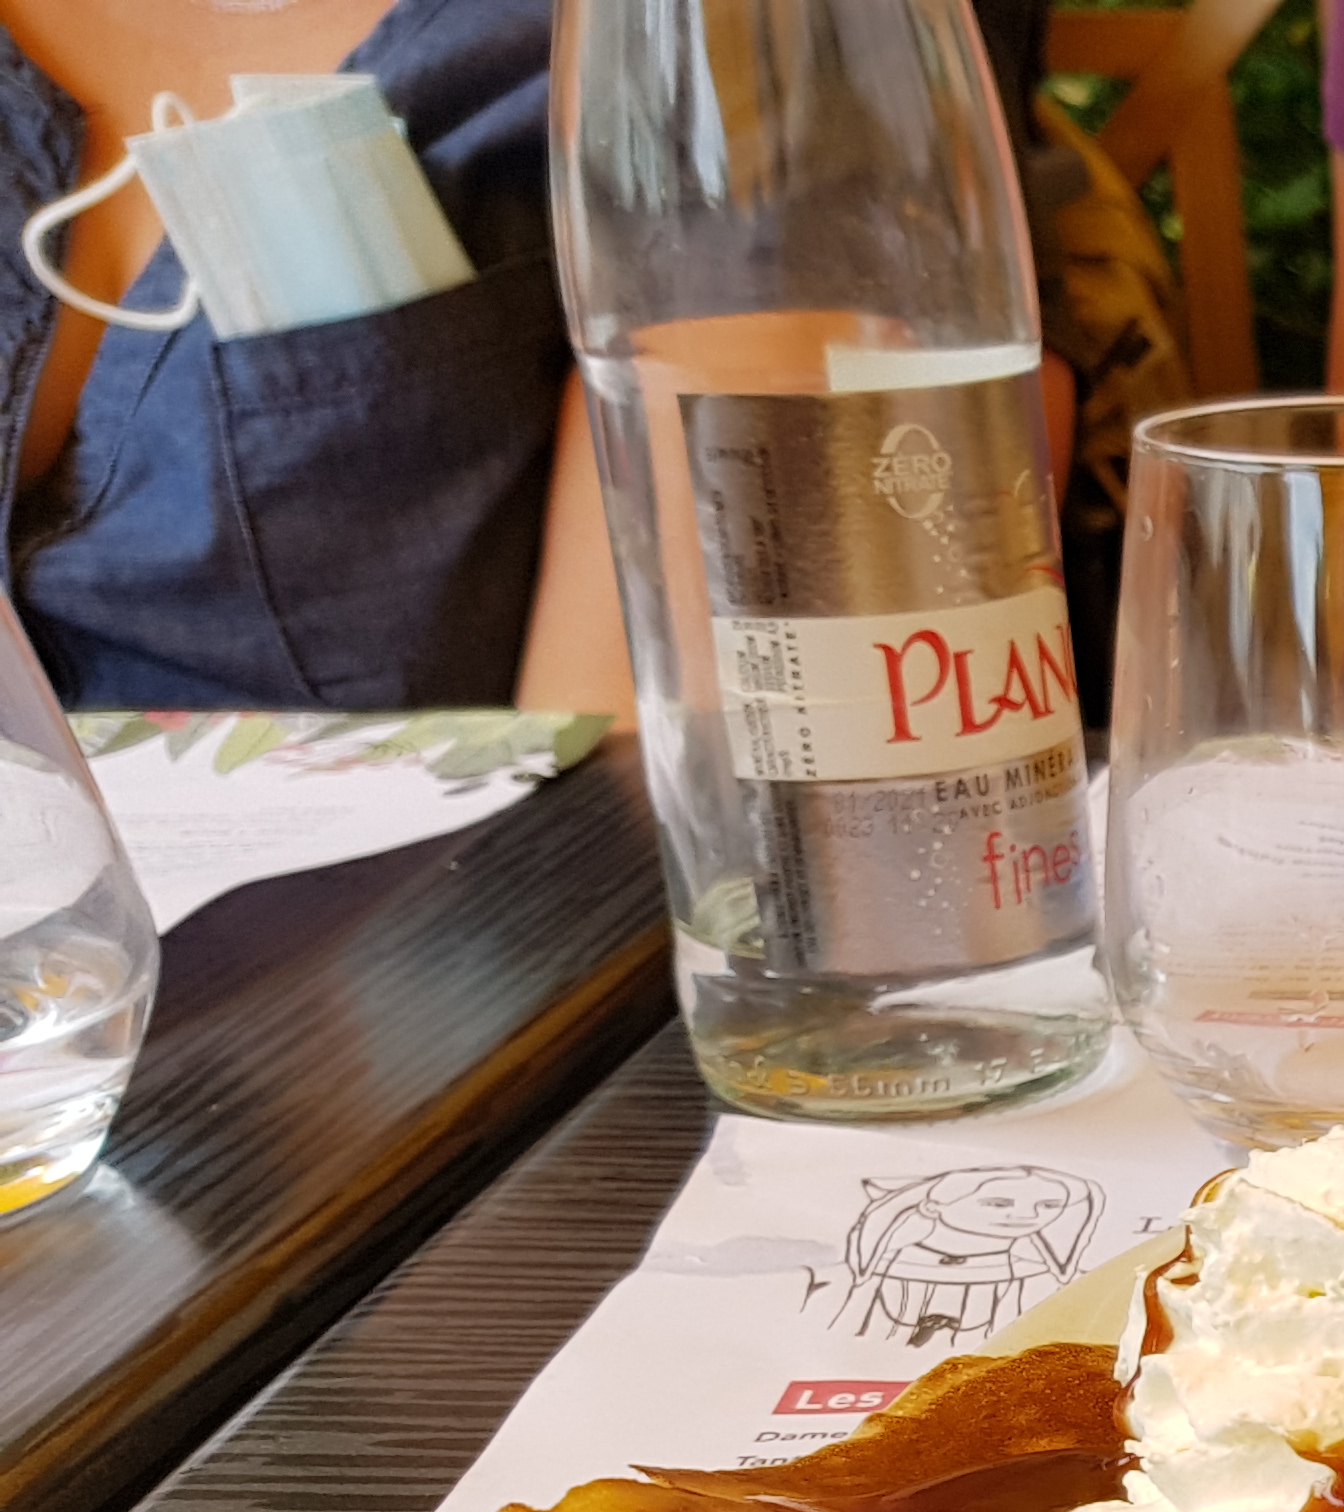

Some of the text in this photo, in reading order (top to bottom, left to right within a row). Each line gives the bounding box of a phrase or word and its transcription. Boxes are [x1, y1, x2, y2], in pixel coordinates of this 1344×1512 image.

[935, 774, 990, 802] EAU
[795, 1389, 885, 1411] Les
[754, 1431, 849, 1443] Dame
[736, 1455, 800, 1468] Tan
